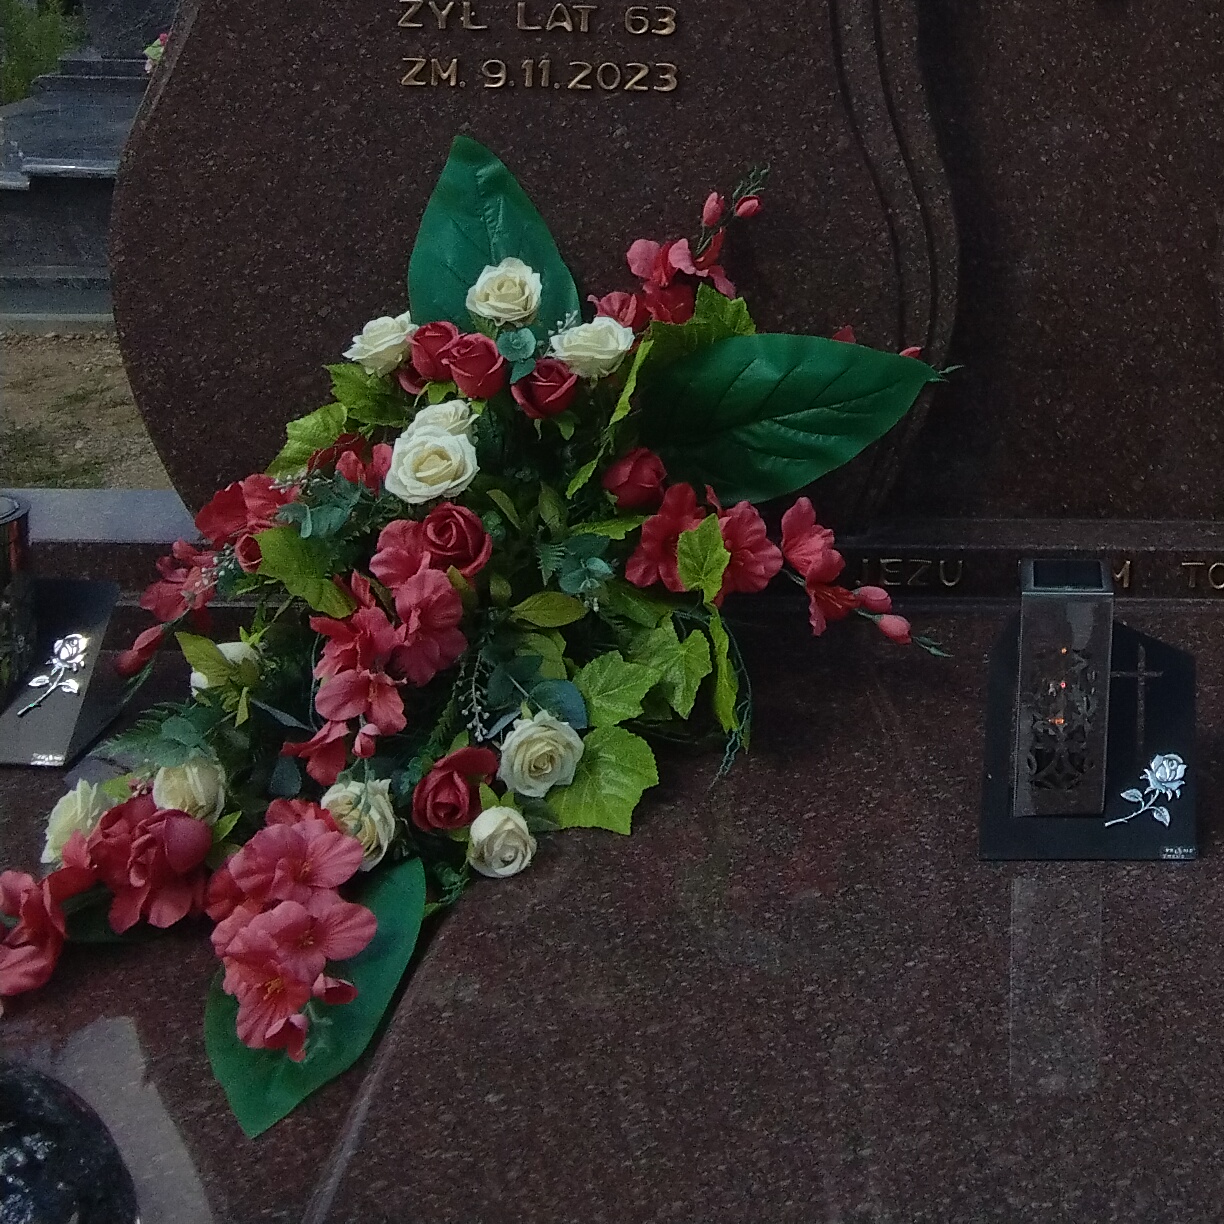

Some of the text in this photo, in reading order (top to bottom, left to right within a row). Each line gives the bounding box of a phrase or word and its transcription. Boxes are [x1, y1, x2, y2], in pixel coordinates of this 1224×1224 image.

[516, 1, 598, 33] LAT
[624, 6, 678, 36] 63
[400, 57, 679, 92] ZM. 9.11.2023
